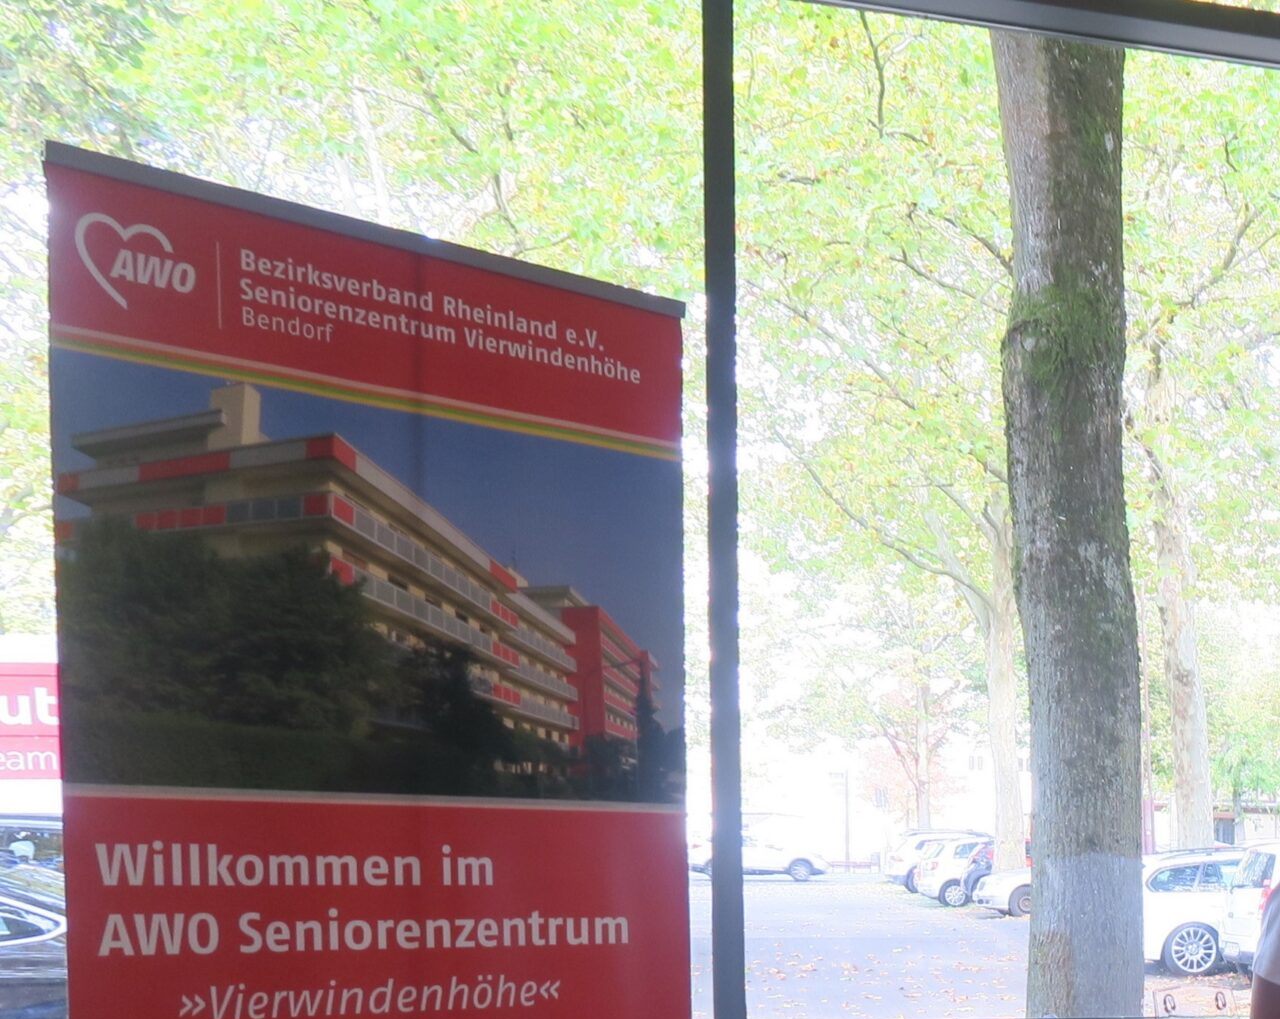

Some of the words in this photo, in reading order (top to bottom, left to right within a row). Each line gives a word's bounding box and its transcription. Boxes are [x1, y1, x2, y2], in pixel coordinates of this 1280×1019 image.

[110, 247, 196, 293] AWO
[240, 248, 434, 312] Bezirksverband
[443, 295, 558, 340] Rheinland
[565, 327, 605, 351] e.V.
[240, 277, 456, 345] Seniorenzentrum
[464, 327, 641, 384] Vierwindenhöhe
[241, 306, 334, 343] Bendorf
[96, 841, 422, 888] Willkommen
[442, 845, 495, 887] im
[98, 911, 220, 957] AWO
[240, 908, 629, 955] Seniorenzentrum
